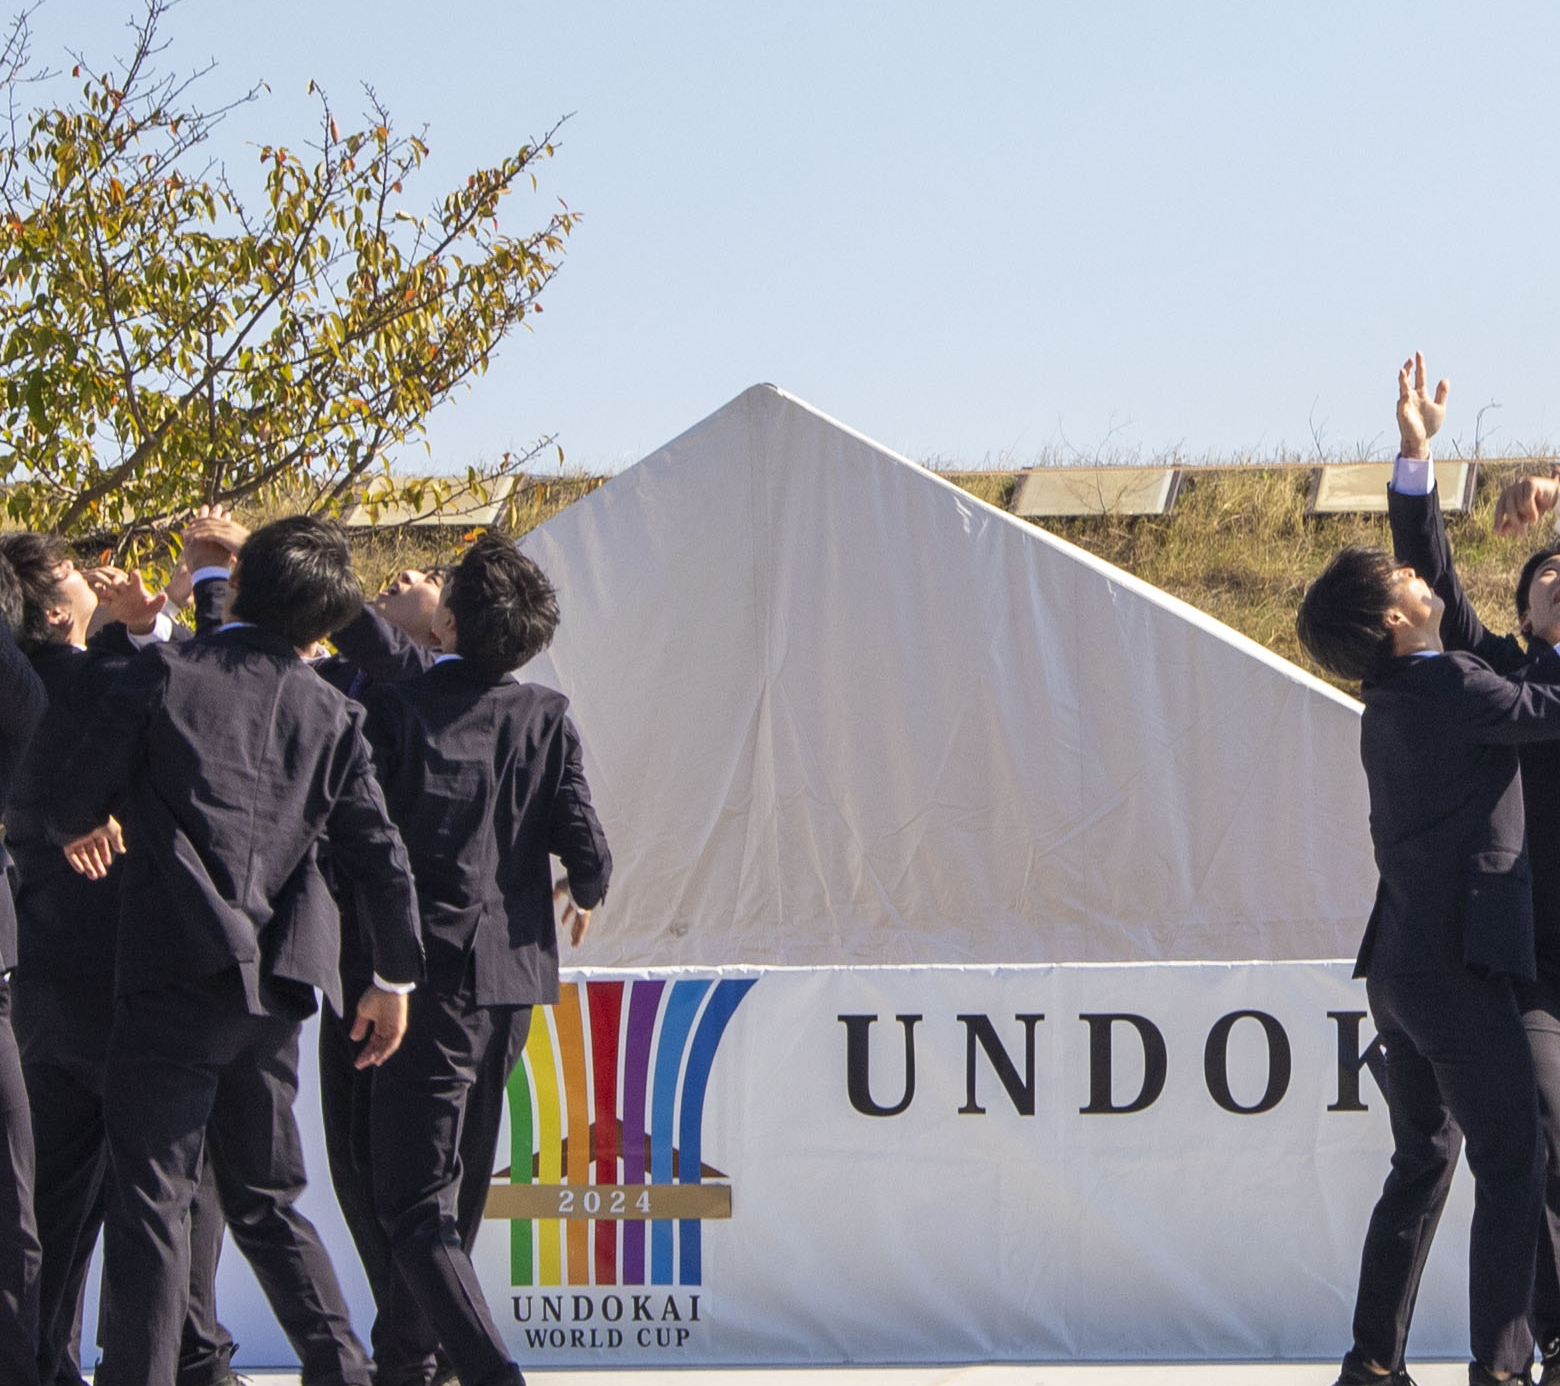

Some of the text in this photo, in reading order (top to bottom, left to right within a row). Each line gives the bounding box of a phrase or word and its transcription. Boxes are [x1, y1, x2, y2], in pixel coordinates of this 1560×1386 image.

[558, 1190, 652, 1214] 2024
[511, 1294, 701, 1323] UNDOKAI
[525, 1327, 691, 1349] WORLD CUP
